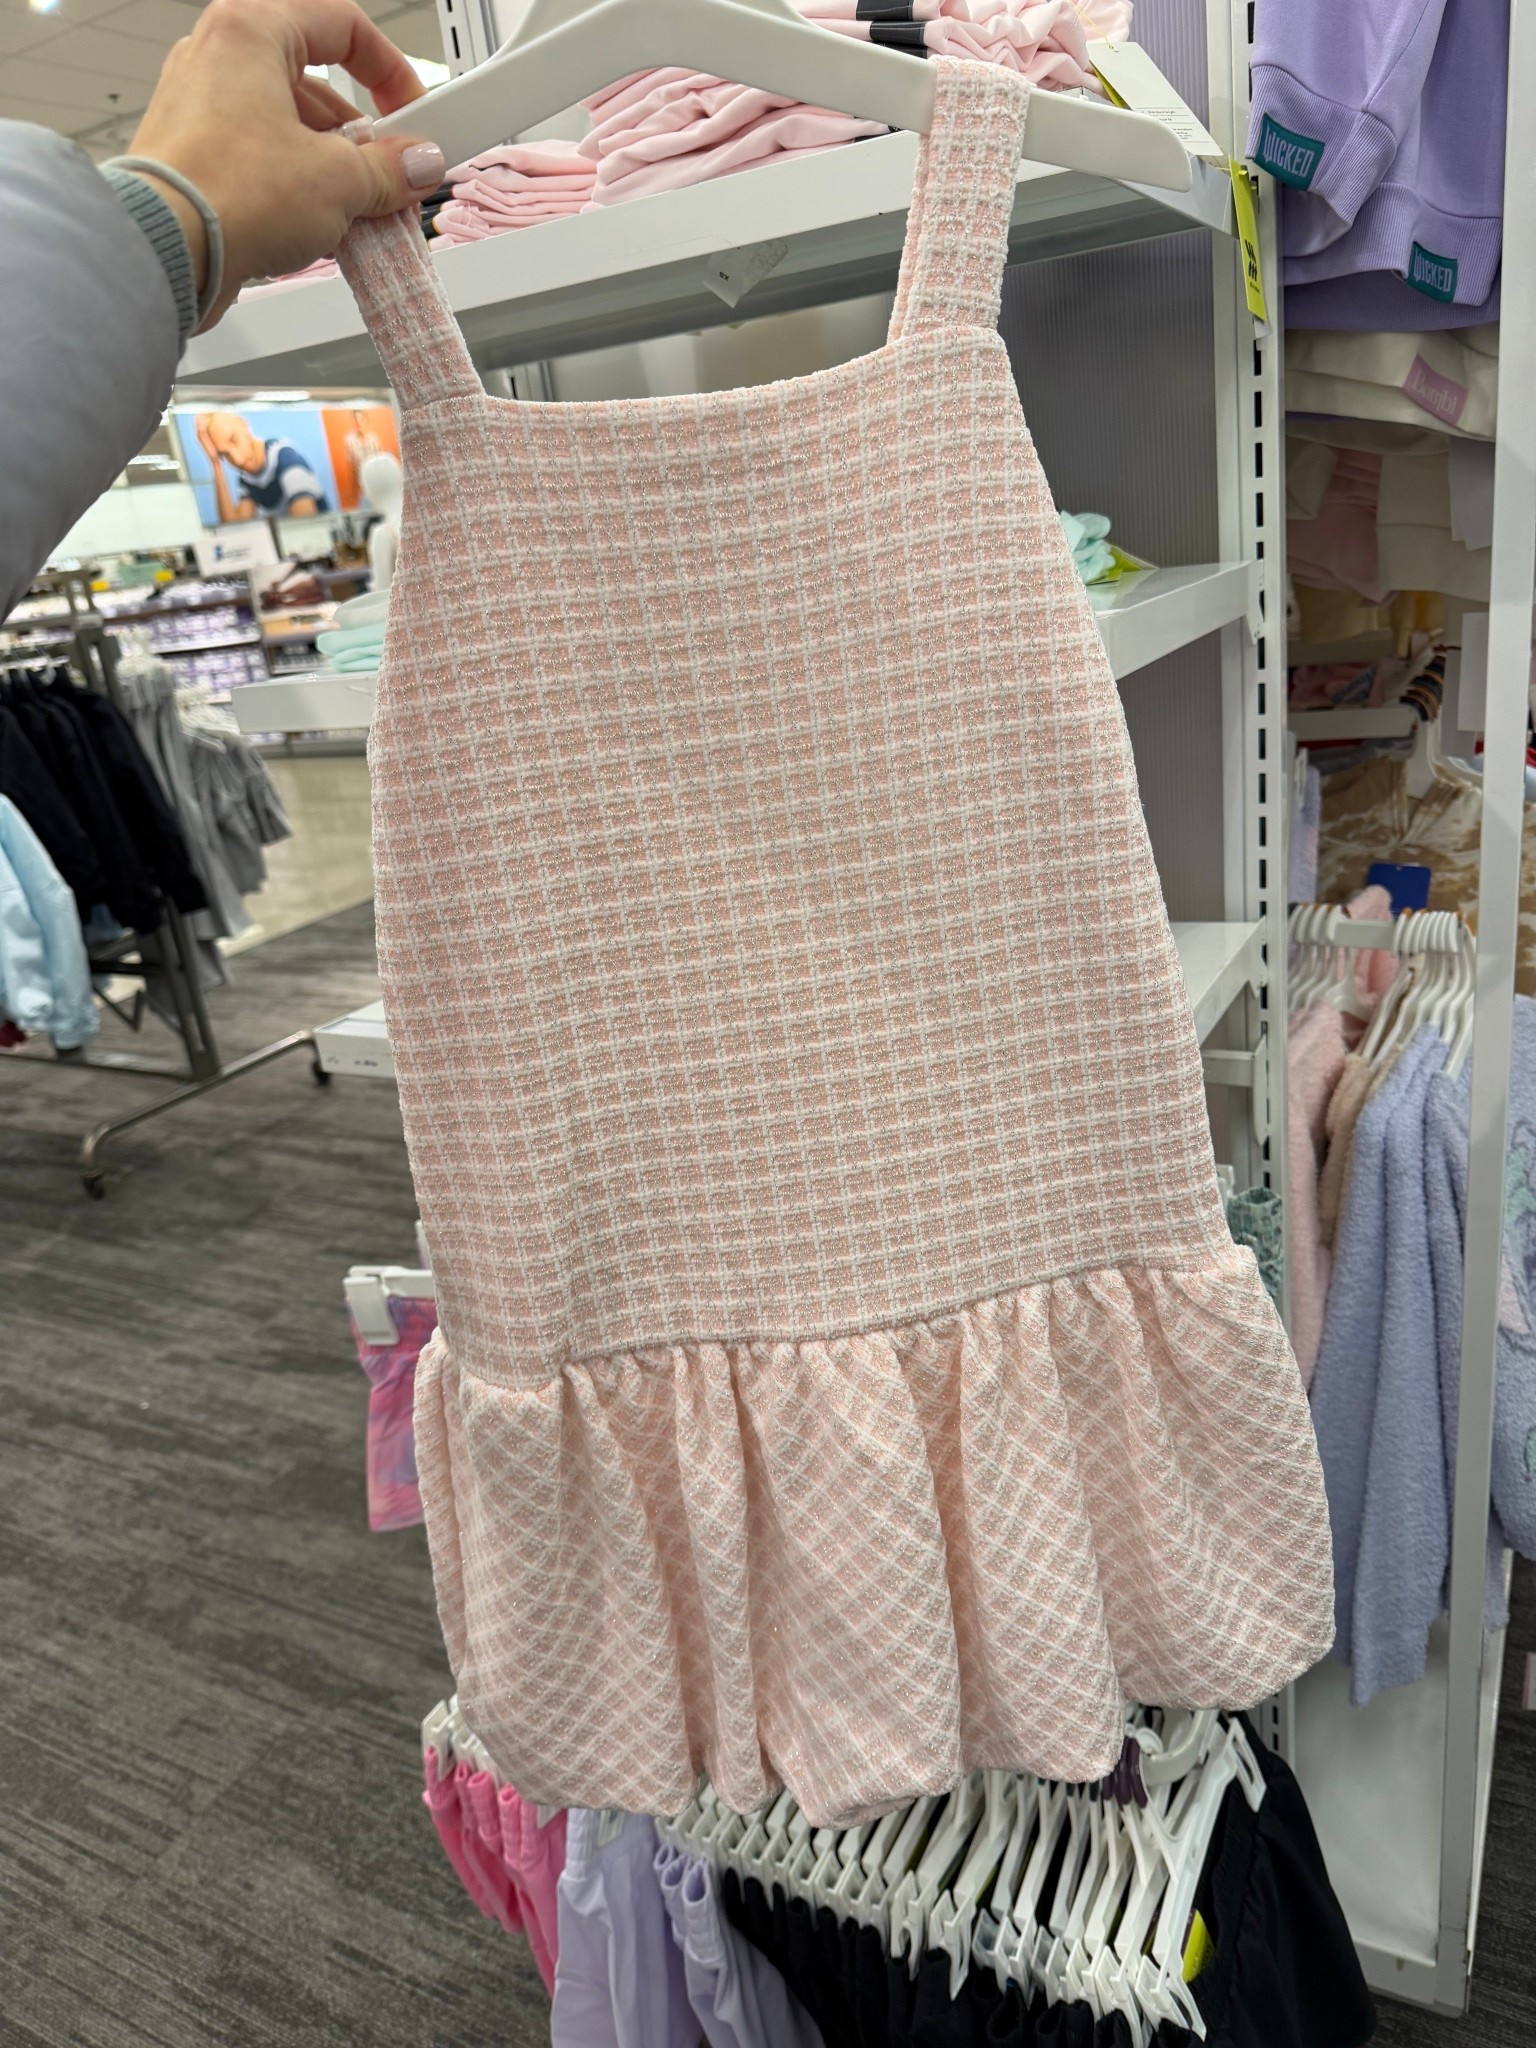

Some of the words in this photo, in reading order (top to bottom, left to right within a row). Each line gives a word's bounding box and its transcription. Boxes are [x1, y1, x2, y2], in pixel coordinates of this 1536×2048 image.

[1263, 122, 1315, 178] WICKED
[1413, 246, 1453, 292] WICKED
[1411, 367, 1458, 414] Bambi
